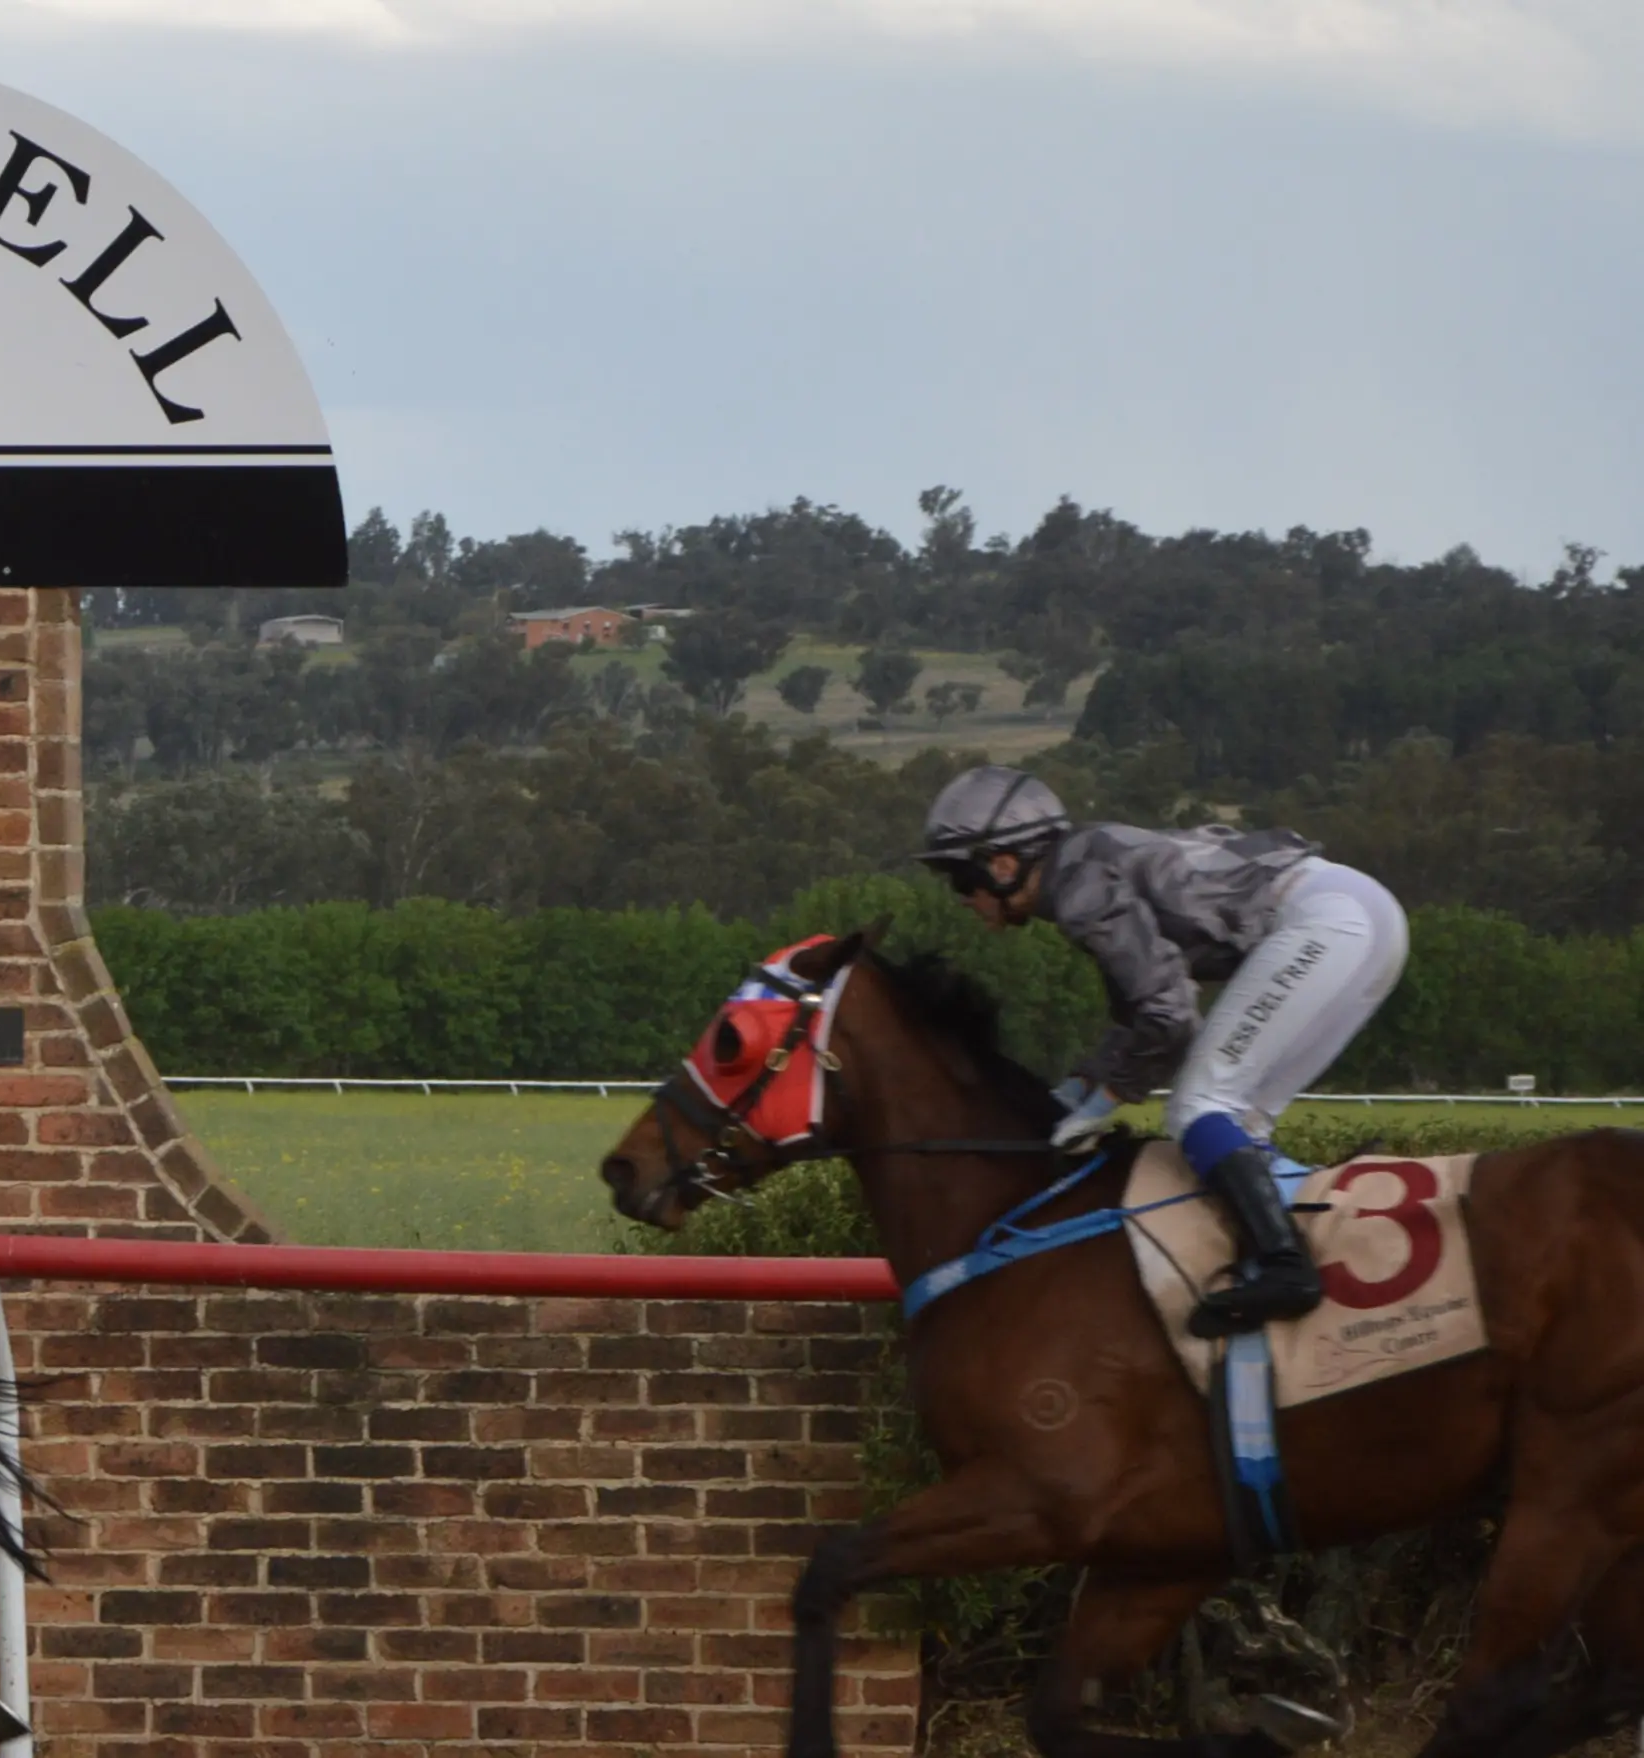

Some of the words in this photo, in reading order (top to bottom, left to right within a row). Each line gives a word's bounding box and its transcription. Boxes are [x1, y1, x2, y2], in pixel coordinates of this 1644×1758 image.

[1218, 1021, 1261, 1065] JESS
[1245, 992, 1288, 1023] DEL
[1319, 1161, 1442, 1309] 3
